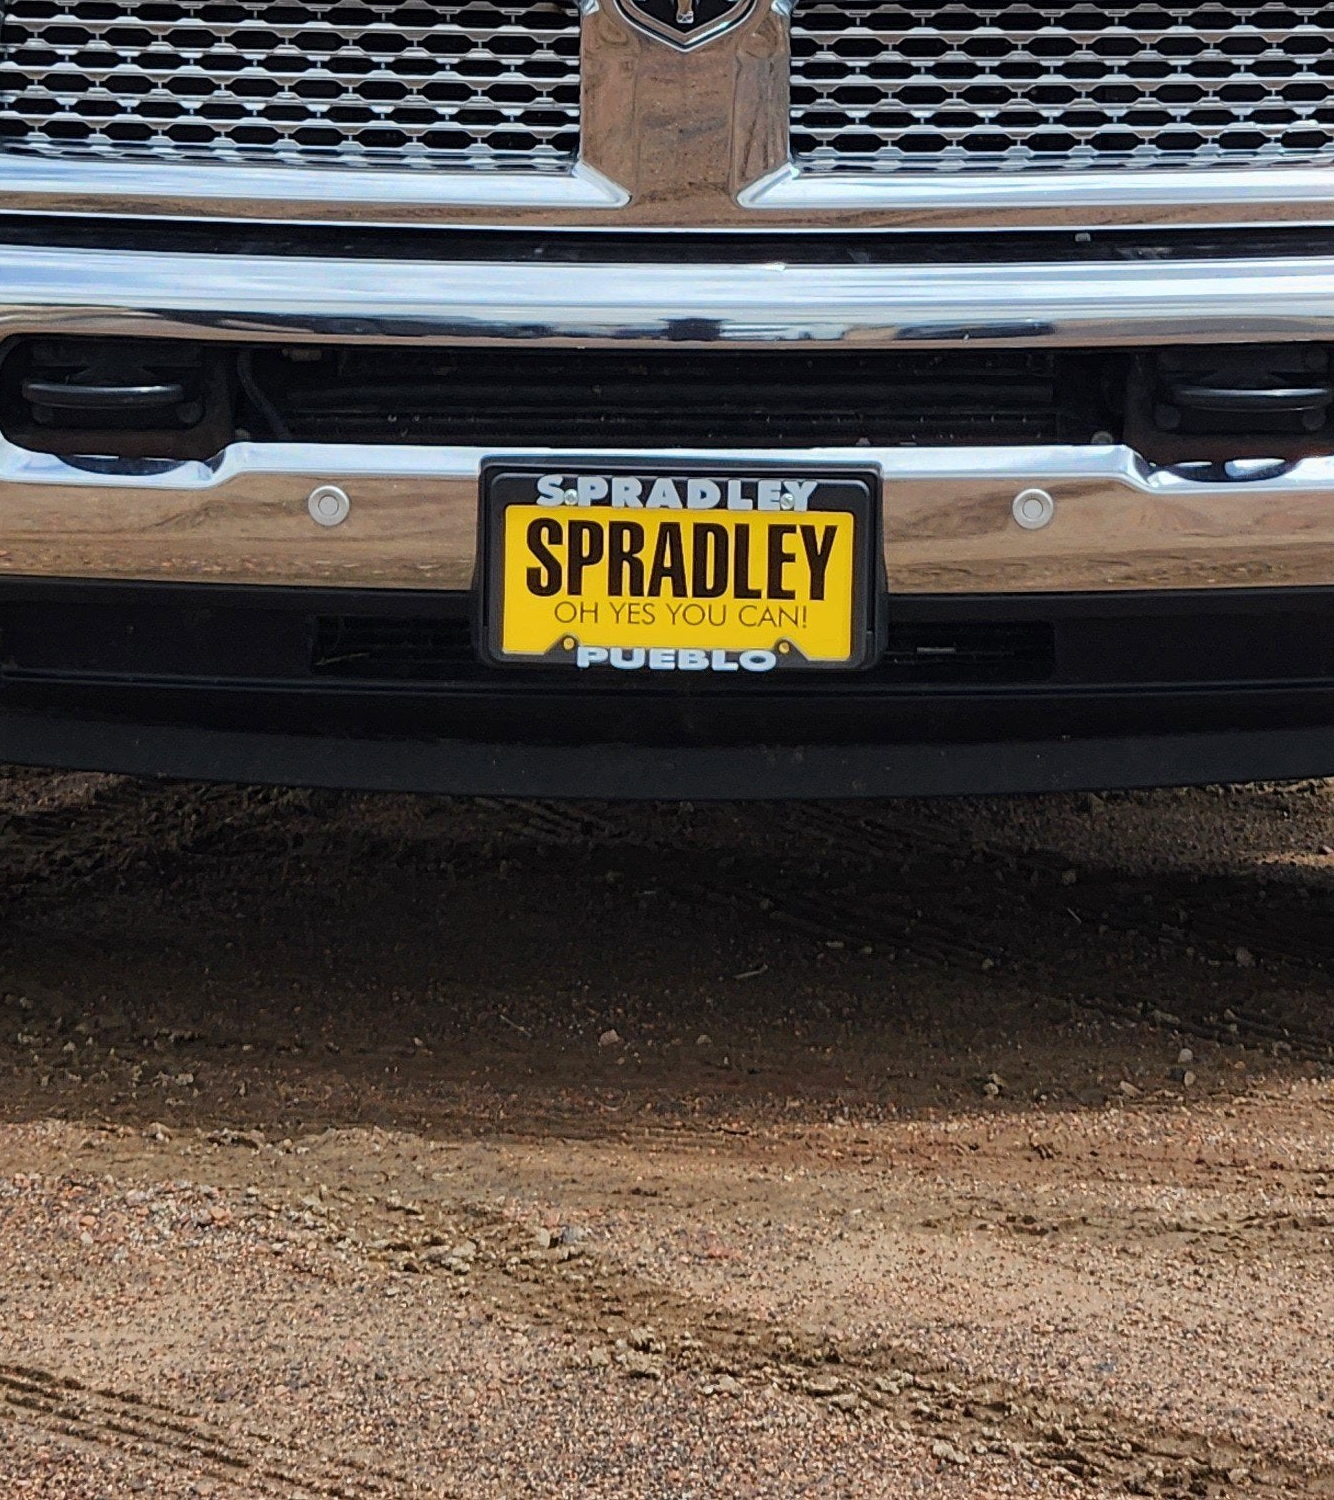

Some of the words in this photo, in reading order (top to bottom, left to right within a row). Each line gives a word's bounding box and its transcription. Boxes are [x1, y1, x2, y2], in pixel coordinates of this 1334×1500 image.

[536, 475, 818, 512] SPRADLEY
[526, 517, 838, 601] SPRADLEY
[554, 601, 598, 624] OH
[609, 602, 655, 625] YES
[666, 603, 727, 626] YOU
[738, 605, 807, 628] CAN!
[577, 647, 777, 672] PUEBLO
